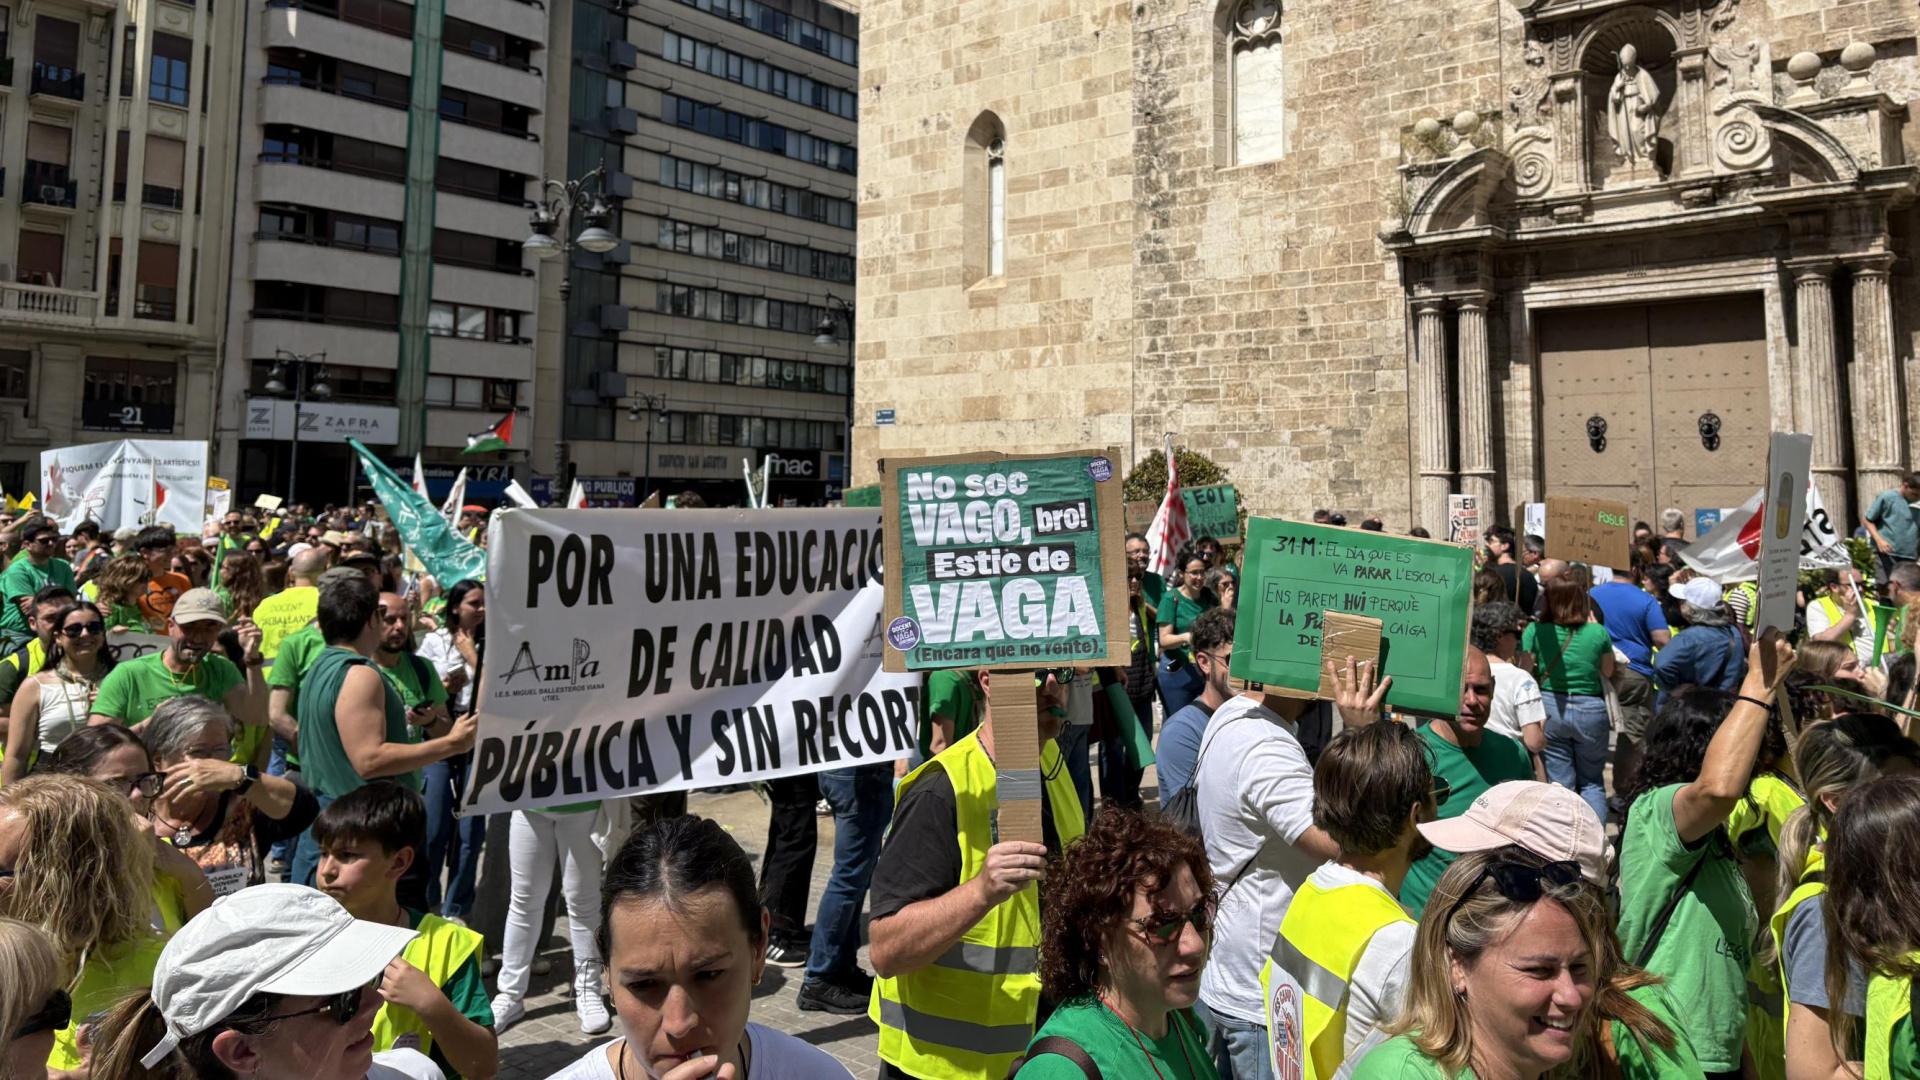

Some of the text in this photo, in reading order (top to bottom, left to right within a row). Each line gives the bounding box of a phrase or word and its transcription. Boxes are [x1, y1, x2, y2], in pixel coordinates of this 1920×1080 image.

[121, 406, 144, 425] 21
[324, 415, 380, 429] ZAFRA
[769, 453, 813, 476] fnac
[593, 481, 636, 496] PUBLICO
[907, 471, 1030, 501] No soc
[908, 498, 1089, 547] VAGO, bro!
[933, 546, 1070, 578] Estic de
[1271, 535, 1323, 557] 31-M:
[1325, 541, 1341, 558] EL
[1367, 550, 1392, 564] QUE
[1396, 552, 1412, 565] ES
[526, 533, 615, 608] POR
[644, 531, 721, 603] UNA
[1333, 562, 1449, 589] VA PARAR L'ESCOLA
[1265, 582, 1292, 604] ENS
[1298, 592, 1338, 609] PAREM
[909, 575, 1101, 645] VAGA
[1279, 608, 1294, 627] LA
[893, 629, 914, 642] VAGA
[627, 625, 678, 698] DE
[690, 614, 842, 690] CALIDAD
[914, 643, 981, 663] (Encara
[985, 644, 1016, 662] que
[1018, 643, 1042, 657] no
[512, 688, 537, 697] MIGUEL
[538, 685, 586, 695] BALLESTEROS
[586, 683, 605, 691] VIANA
[467, 719, 658, 806] PÚBLICA
[666, 713, 693, 781] Y
[711, 704, 781, 776] SIN
